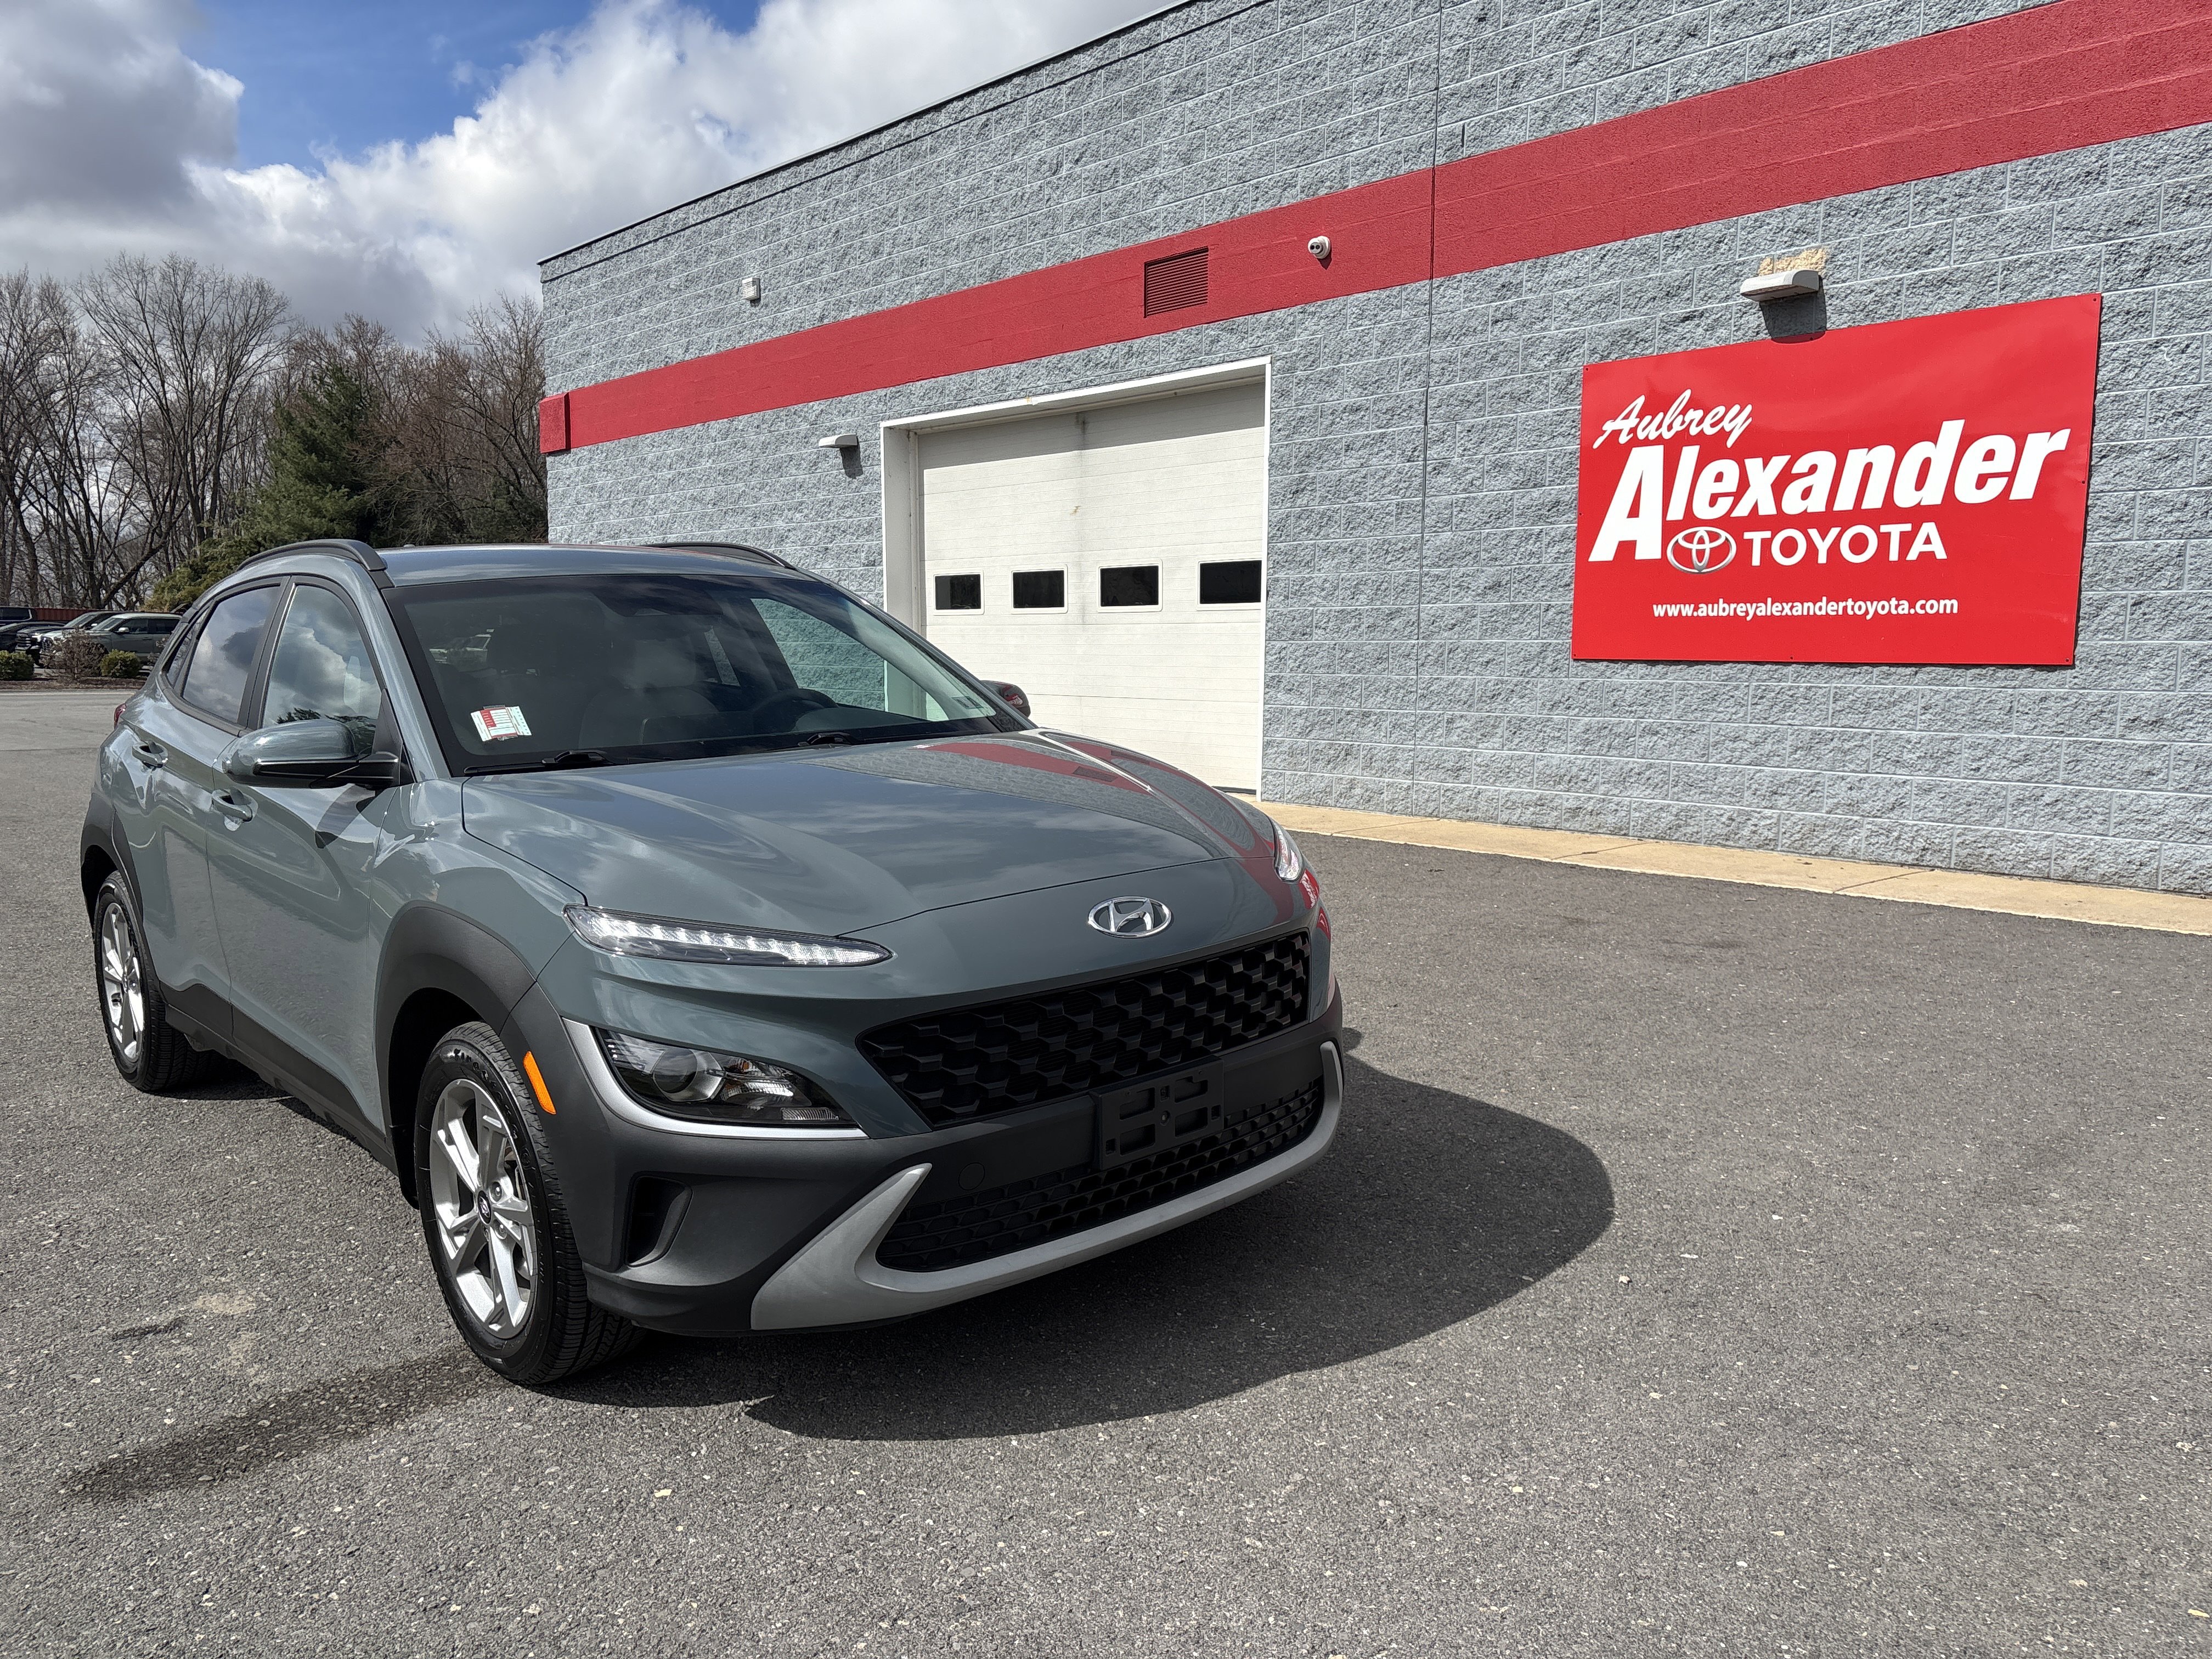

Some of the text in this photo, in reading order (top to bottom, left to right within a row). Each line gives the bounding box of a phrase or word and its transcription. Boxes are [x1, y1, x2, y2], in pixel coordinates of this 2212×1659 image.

[1592, 388, 1752, 448] Aubrey
[1588, 419, 2071, 562] Alexander
[1743, 522, 1948, 566] TOYOTA
[1652, 596, 1958, 621] www.aubreyalexandertoyota.com
